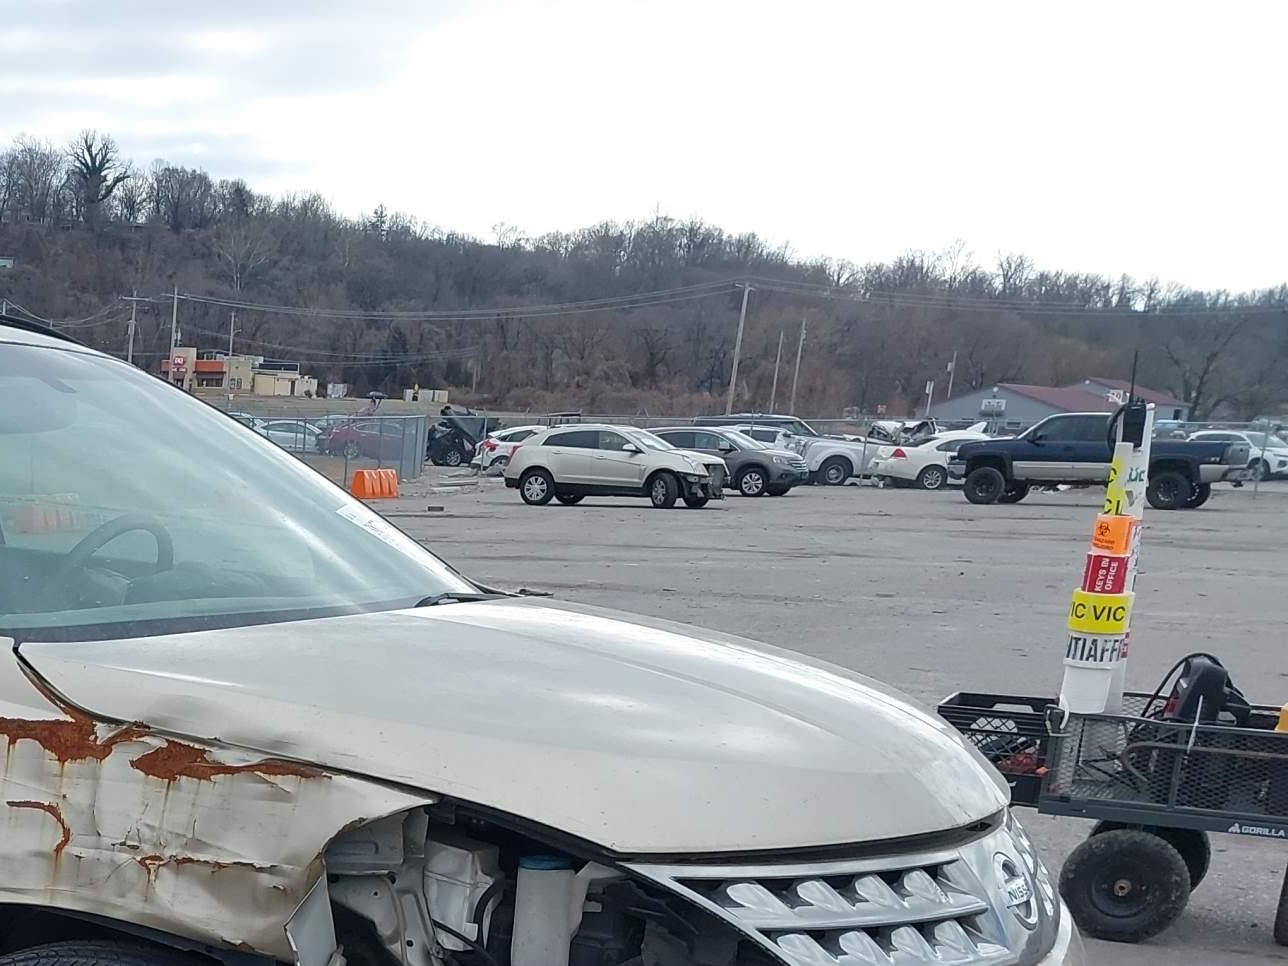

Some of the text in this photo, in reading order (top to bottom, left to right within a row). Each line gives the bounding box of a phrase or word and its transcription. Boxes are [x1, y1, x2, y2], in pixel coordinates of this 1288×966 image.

[1094, 570, 1107, 592] KEYS
[1104, 562, 1119, 591] OFFICE
[1093, 605, 1126, 622] VIC
[1242, 825, 1285, 837] GORILLA
